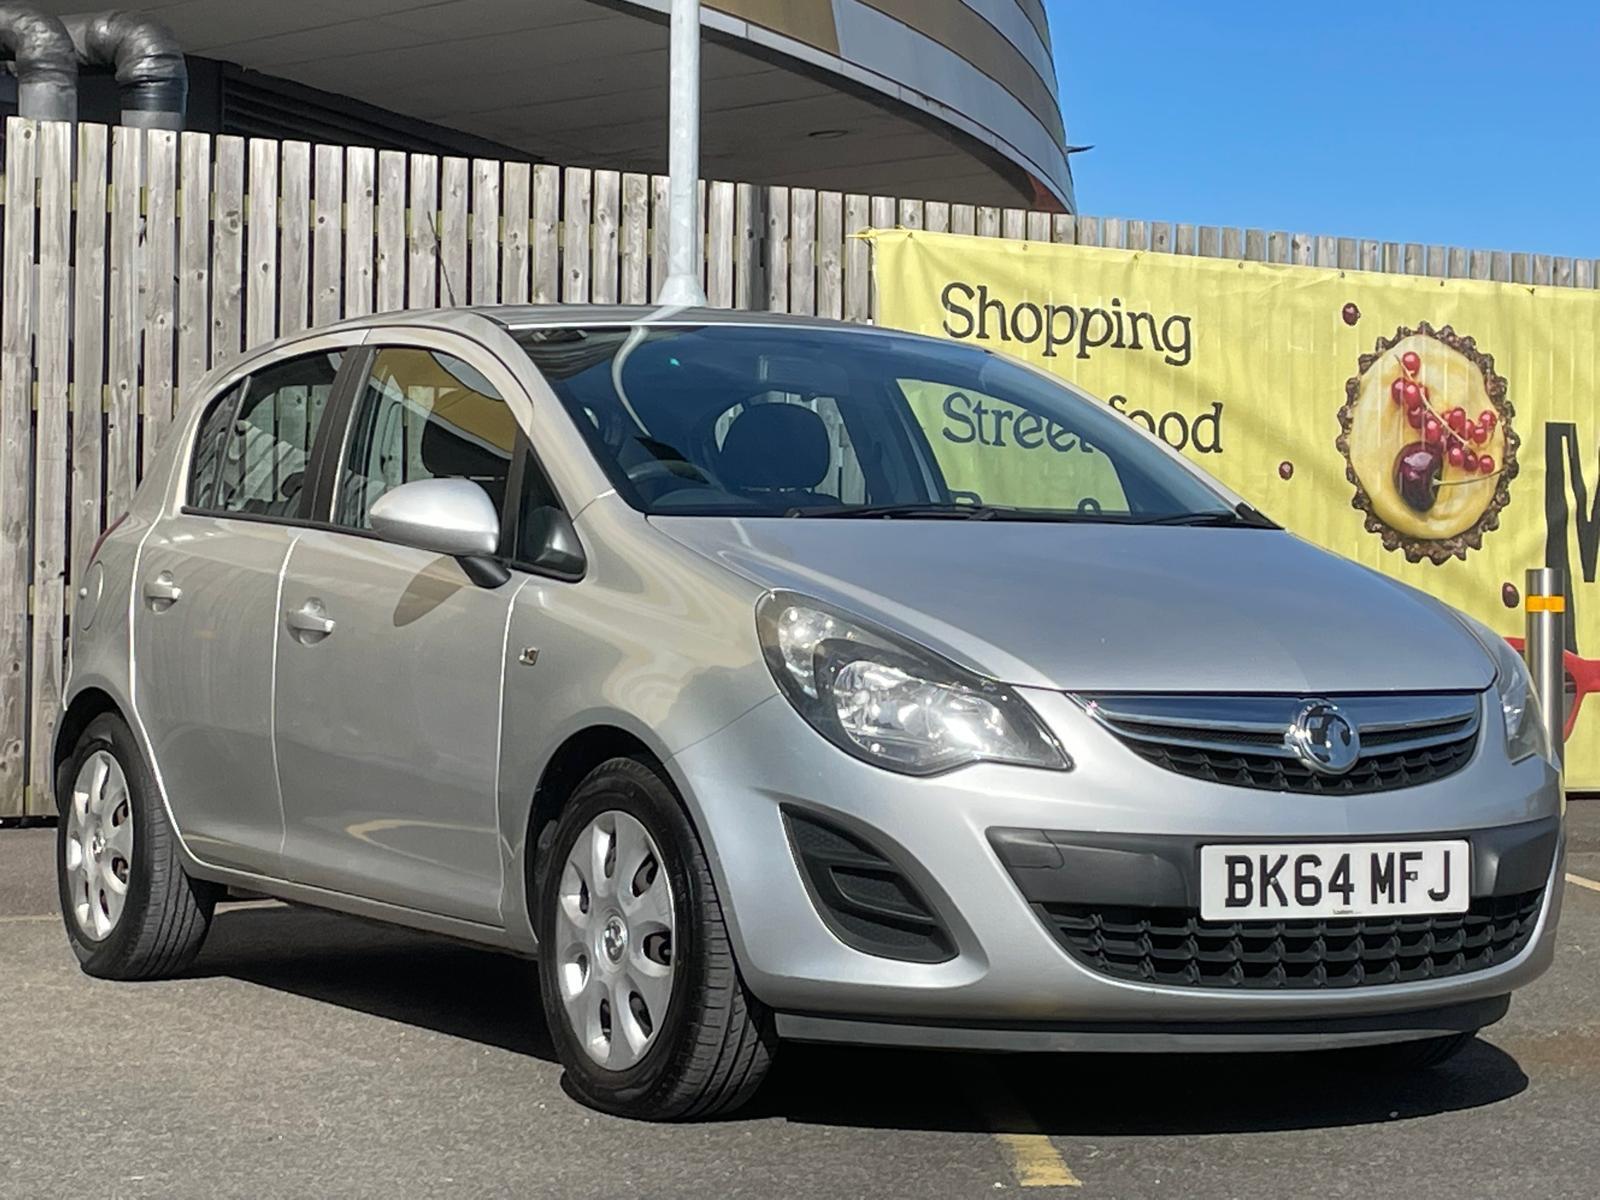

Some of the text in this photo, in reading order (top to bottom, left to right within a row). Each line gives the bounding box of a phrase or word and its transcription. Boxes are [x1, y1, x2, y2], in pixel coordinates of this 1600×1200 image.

[941, 282, 1191, 366] Shopping
[1224, 850, 1451, 908] BK64 MFJ
